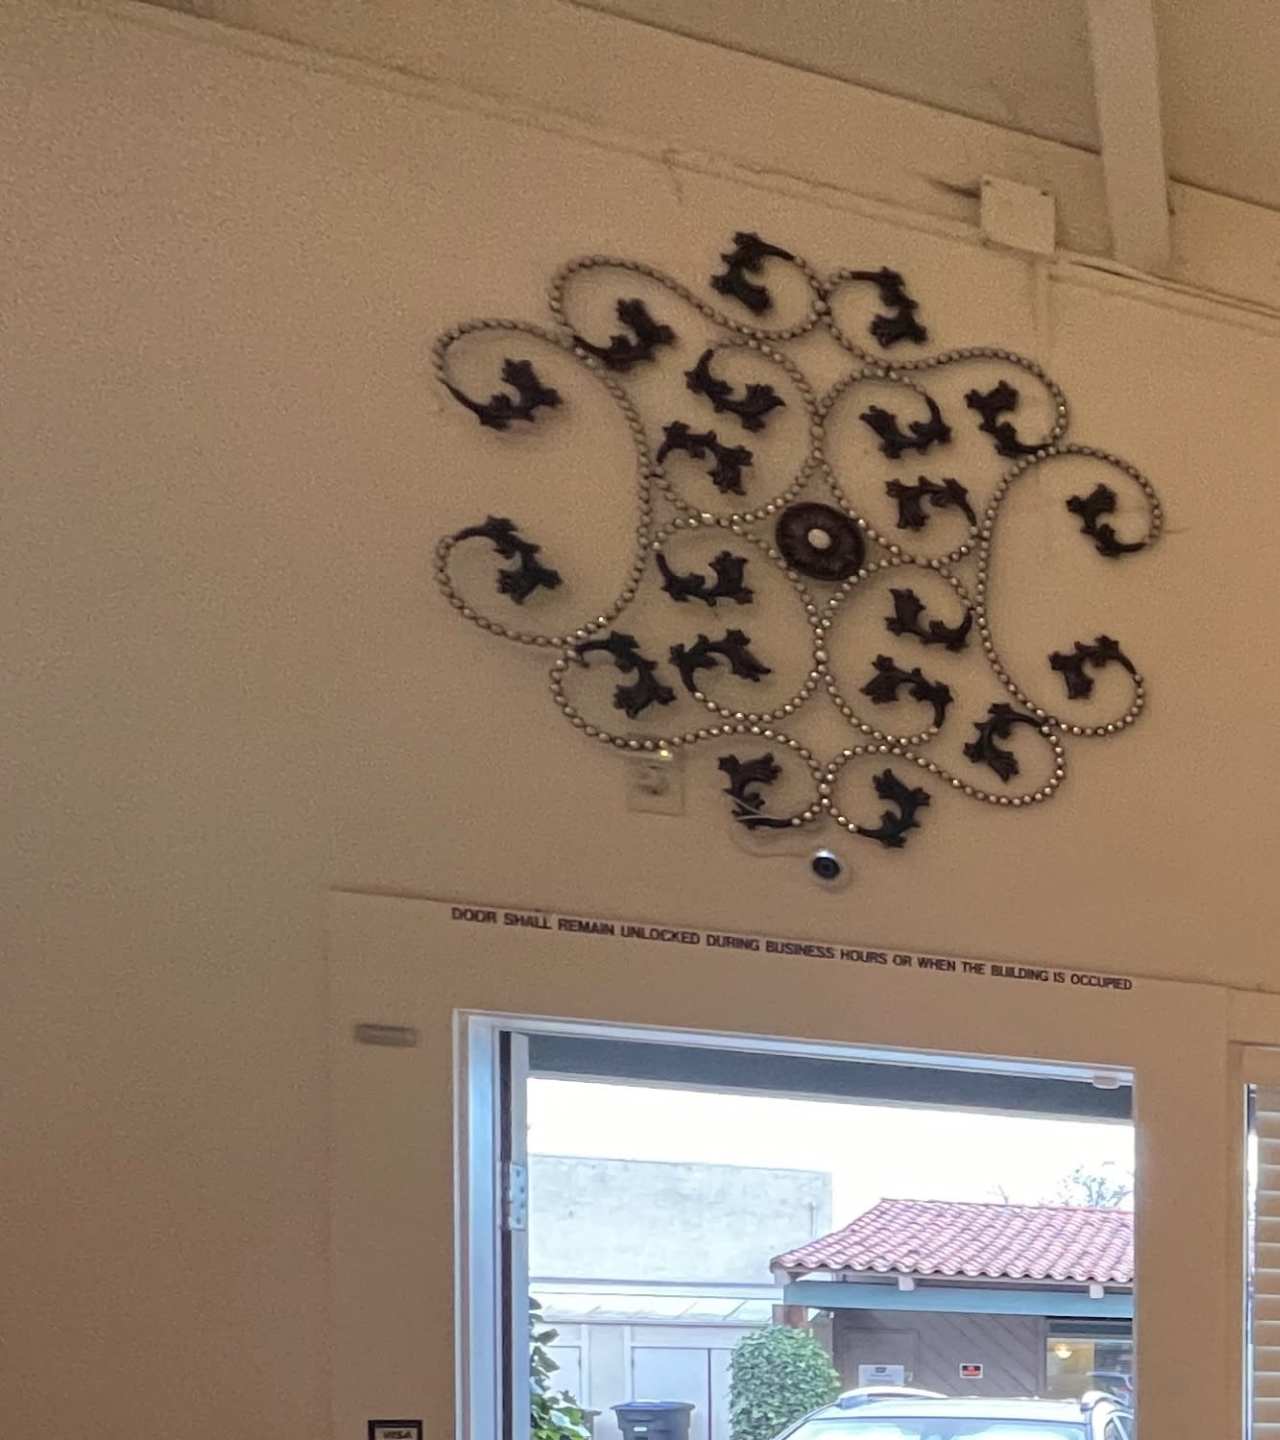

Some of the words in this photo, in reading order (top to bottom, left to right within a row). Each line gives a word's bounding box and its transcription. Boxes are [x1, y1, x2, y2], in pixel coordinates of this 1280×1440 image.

[452, 906, 497, 924] DOOR
[503, 912, 552, 931] SHALL
[557, 917, 615, 937] REMAIN
[620, 924, 701, 946] UNLOCKED
[706, 933, 761, 952] DURING
[765, 940, 835, 960] BUSINESS
[840, 947, 888, 966] HOURS
[892, 953, 913, 968] OR
[917, 956, 957, 973] WHEN
[962, 961, 986, 976] THE
[991, 964, 1050, 982] BUILDING
[1053, 971, 1066, 984] IS
